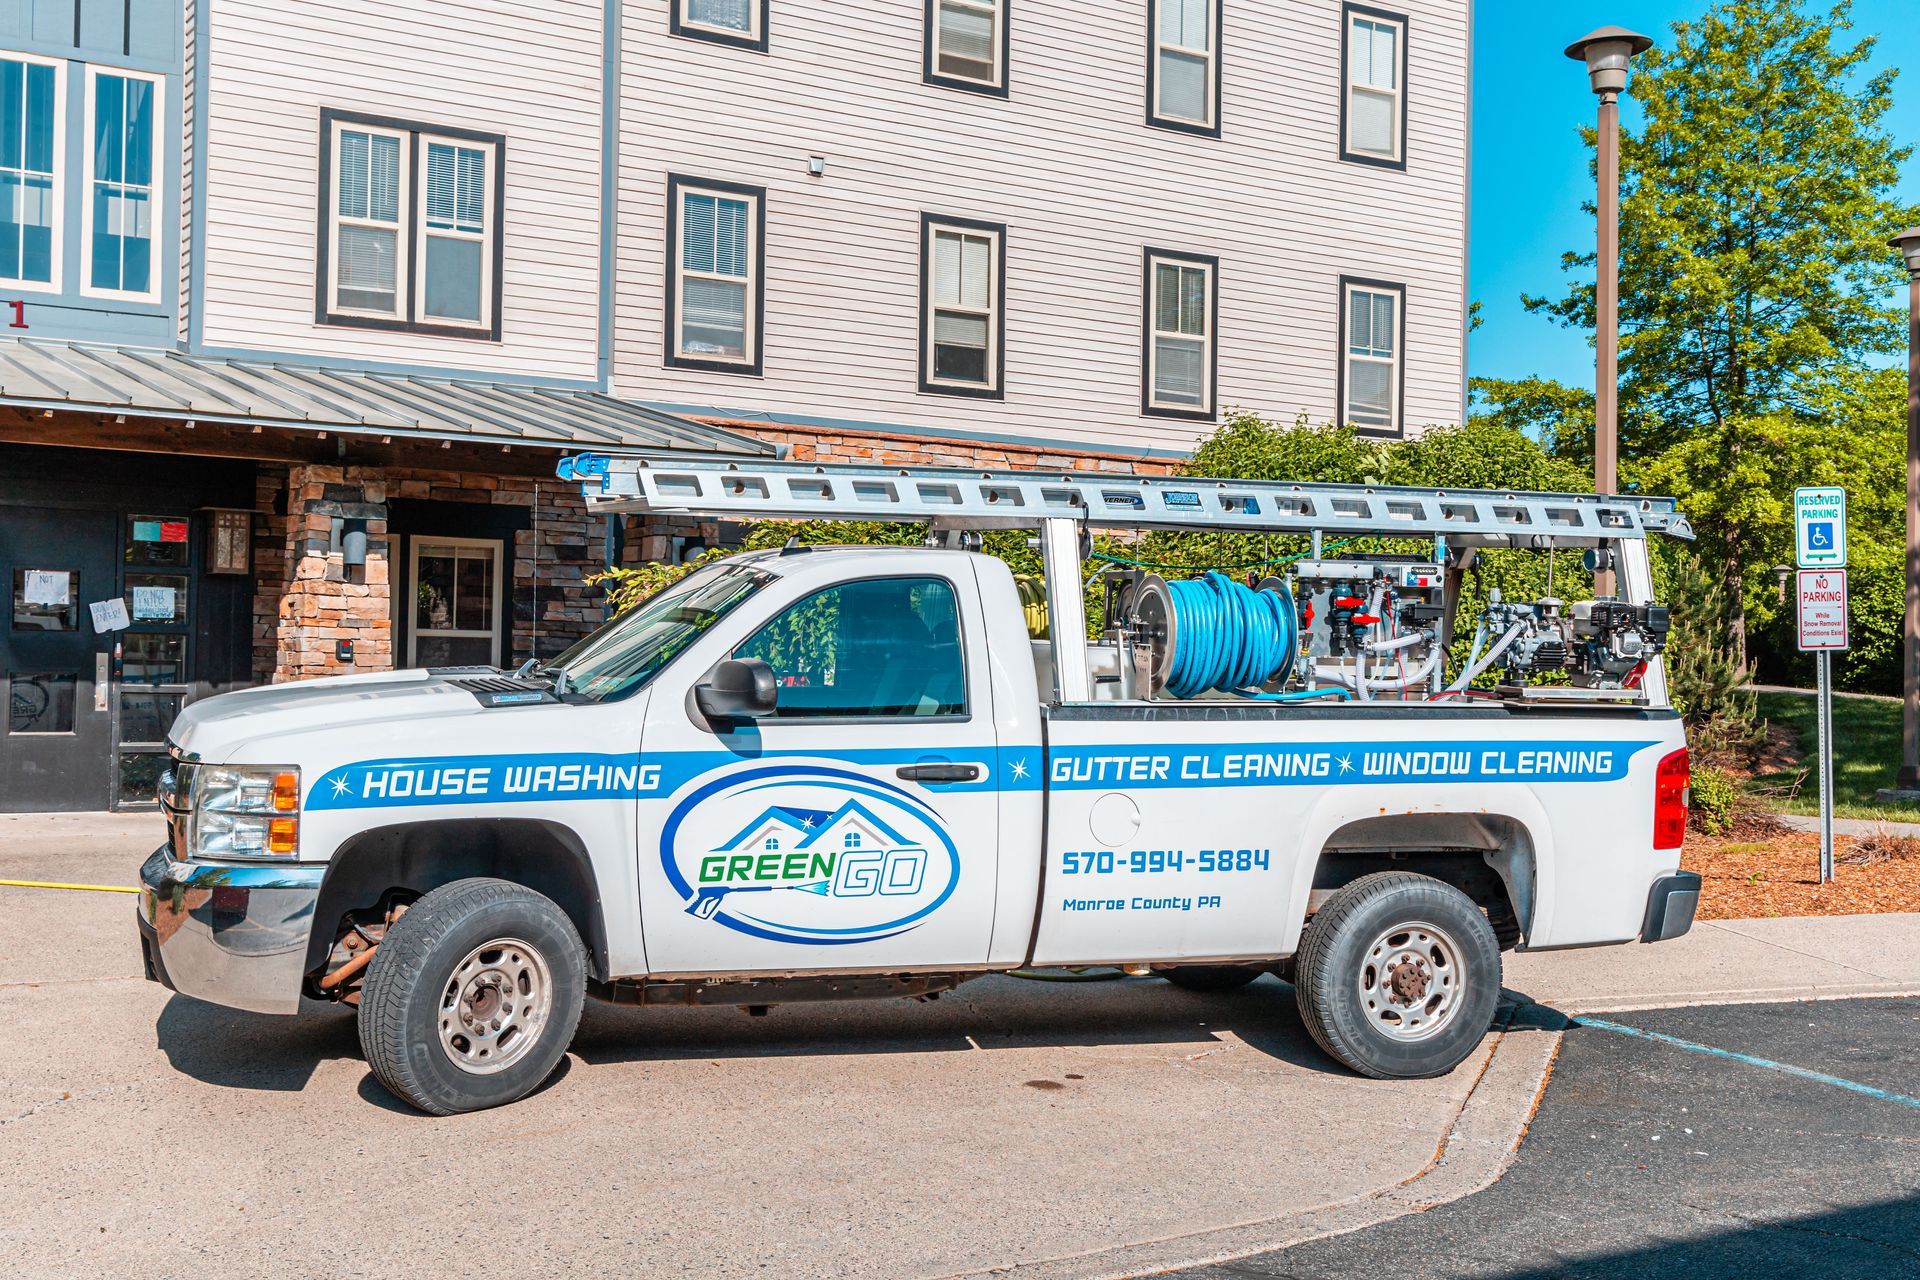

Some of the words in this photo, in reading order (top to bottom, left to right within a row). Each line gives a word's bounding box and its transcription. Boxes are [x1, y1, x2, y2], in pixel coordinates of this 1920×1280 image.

[9, 300, 29, 328] 1
[1799, 495, 1841, 506] RESERVED
[1802, 509, 1839, 519] PARKING
[39, 575, 54, 584] NOT
[1815, 578, 1829, 589] NO
[136, 589, 148, 598] DO
[150, 589, 164, 599] NOT
[1803, 591, 1842, 602] PARKING
[1051, 756, 1170, 782] GUTTER
[1180, 753, 1331, 780] CLEANING
[1363, 751, 1471, 776] WINDOW
[1480, 751, 1613, 775] CLEANING
[362, 767, 491, 799] HOUSE
[503, 764, 662, 793] WASHING
[1062, 849, 1270, 874] 570-994-5884
[1062, 898, 1125, 911] Monroe
[1131, 896, 1191, 911] County
[1198, 896, 1221, 908] PA
